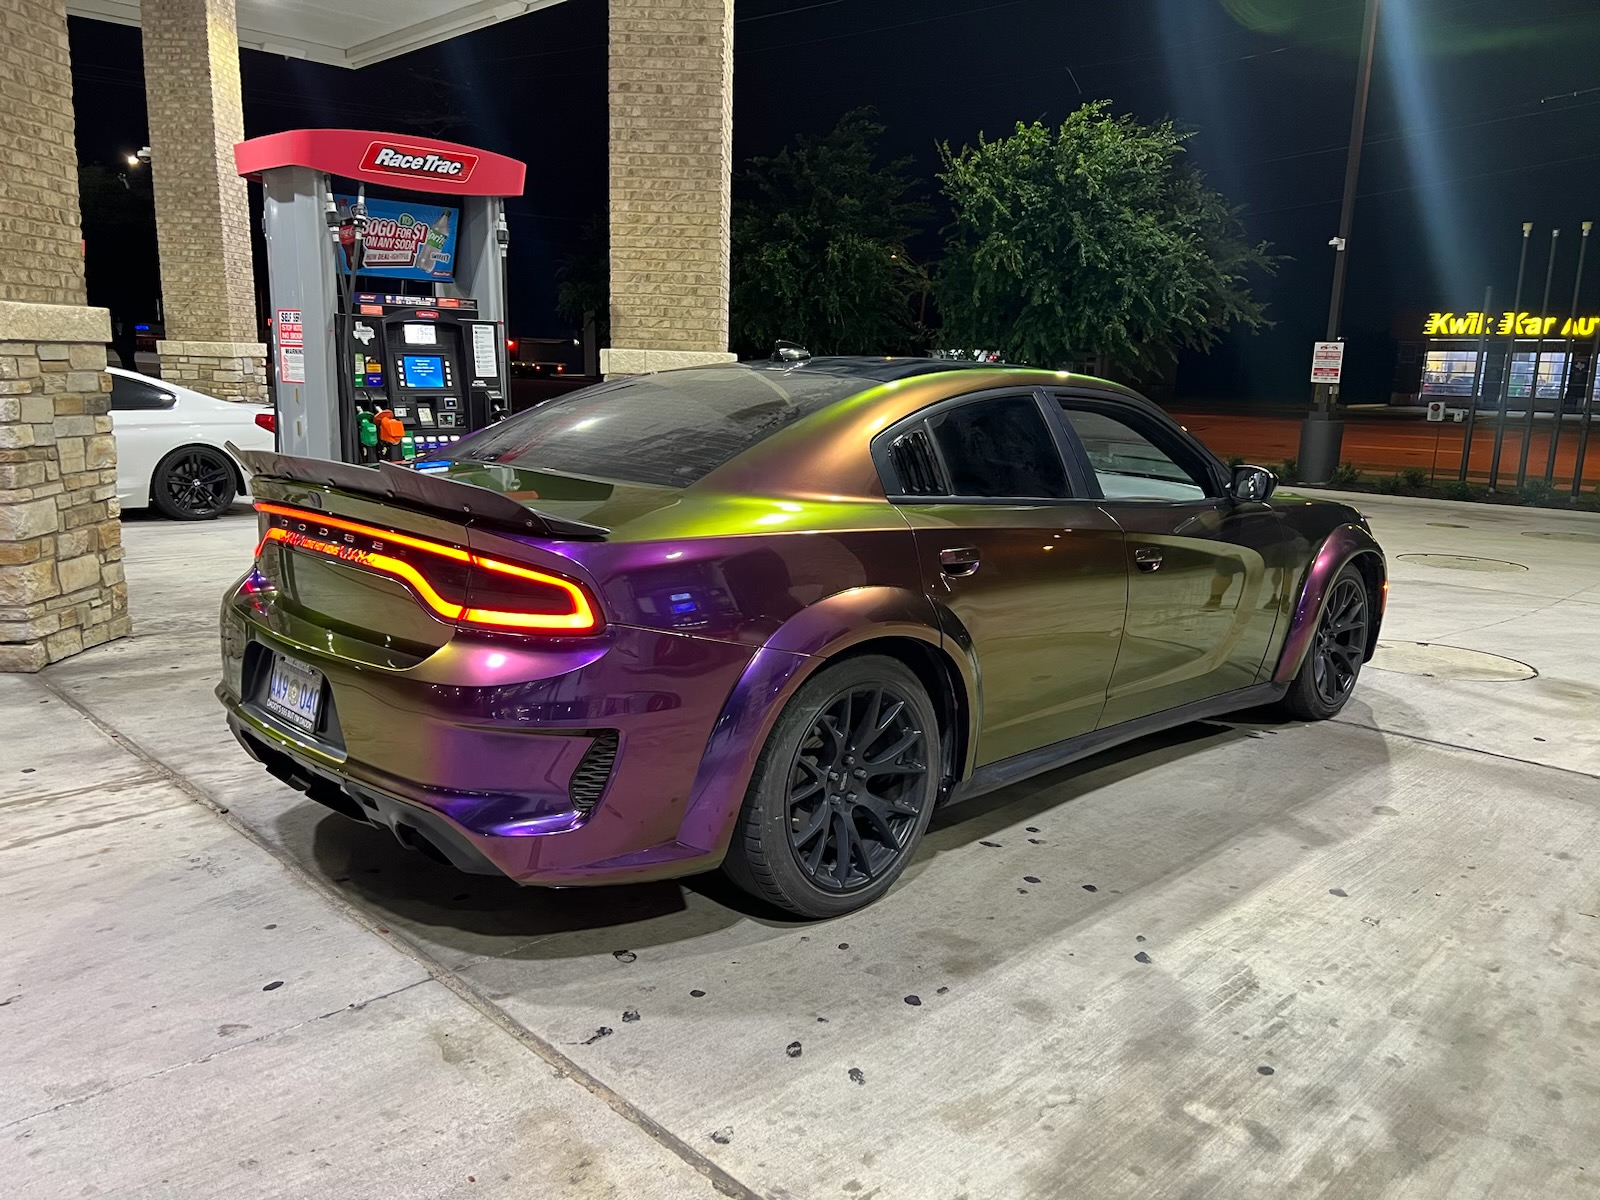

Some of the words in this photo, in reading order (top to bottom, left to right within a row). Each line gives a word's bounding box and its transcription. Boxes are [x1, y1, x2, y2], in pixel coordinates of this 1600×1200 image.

[374, 148, 462, 175] RaceTrac
[395, 227, 412, 240] FOR
[411, 223, 426, 241] $1
[365, 235, 378, 247] ON
[377, 236, 395, 249] ANY
[394, 238, 416, 251] SODA
[1422, 312, 1494, 335] Kwik
[1495, 312, 1557, 335] Kar
